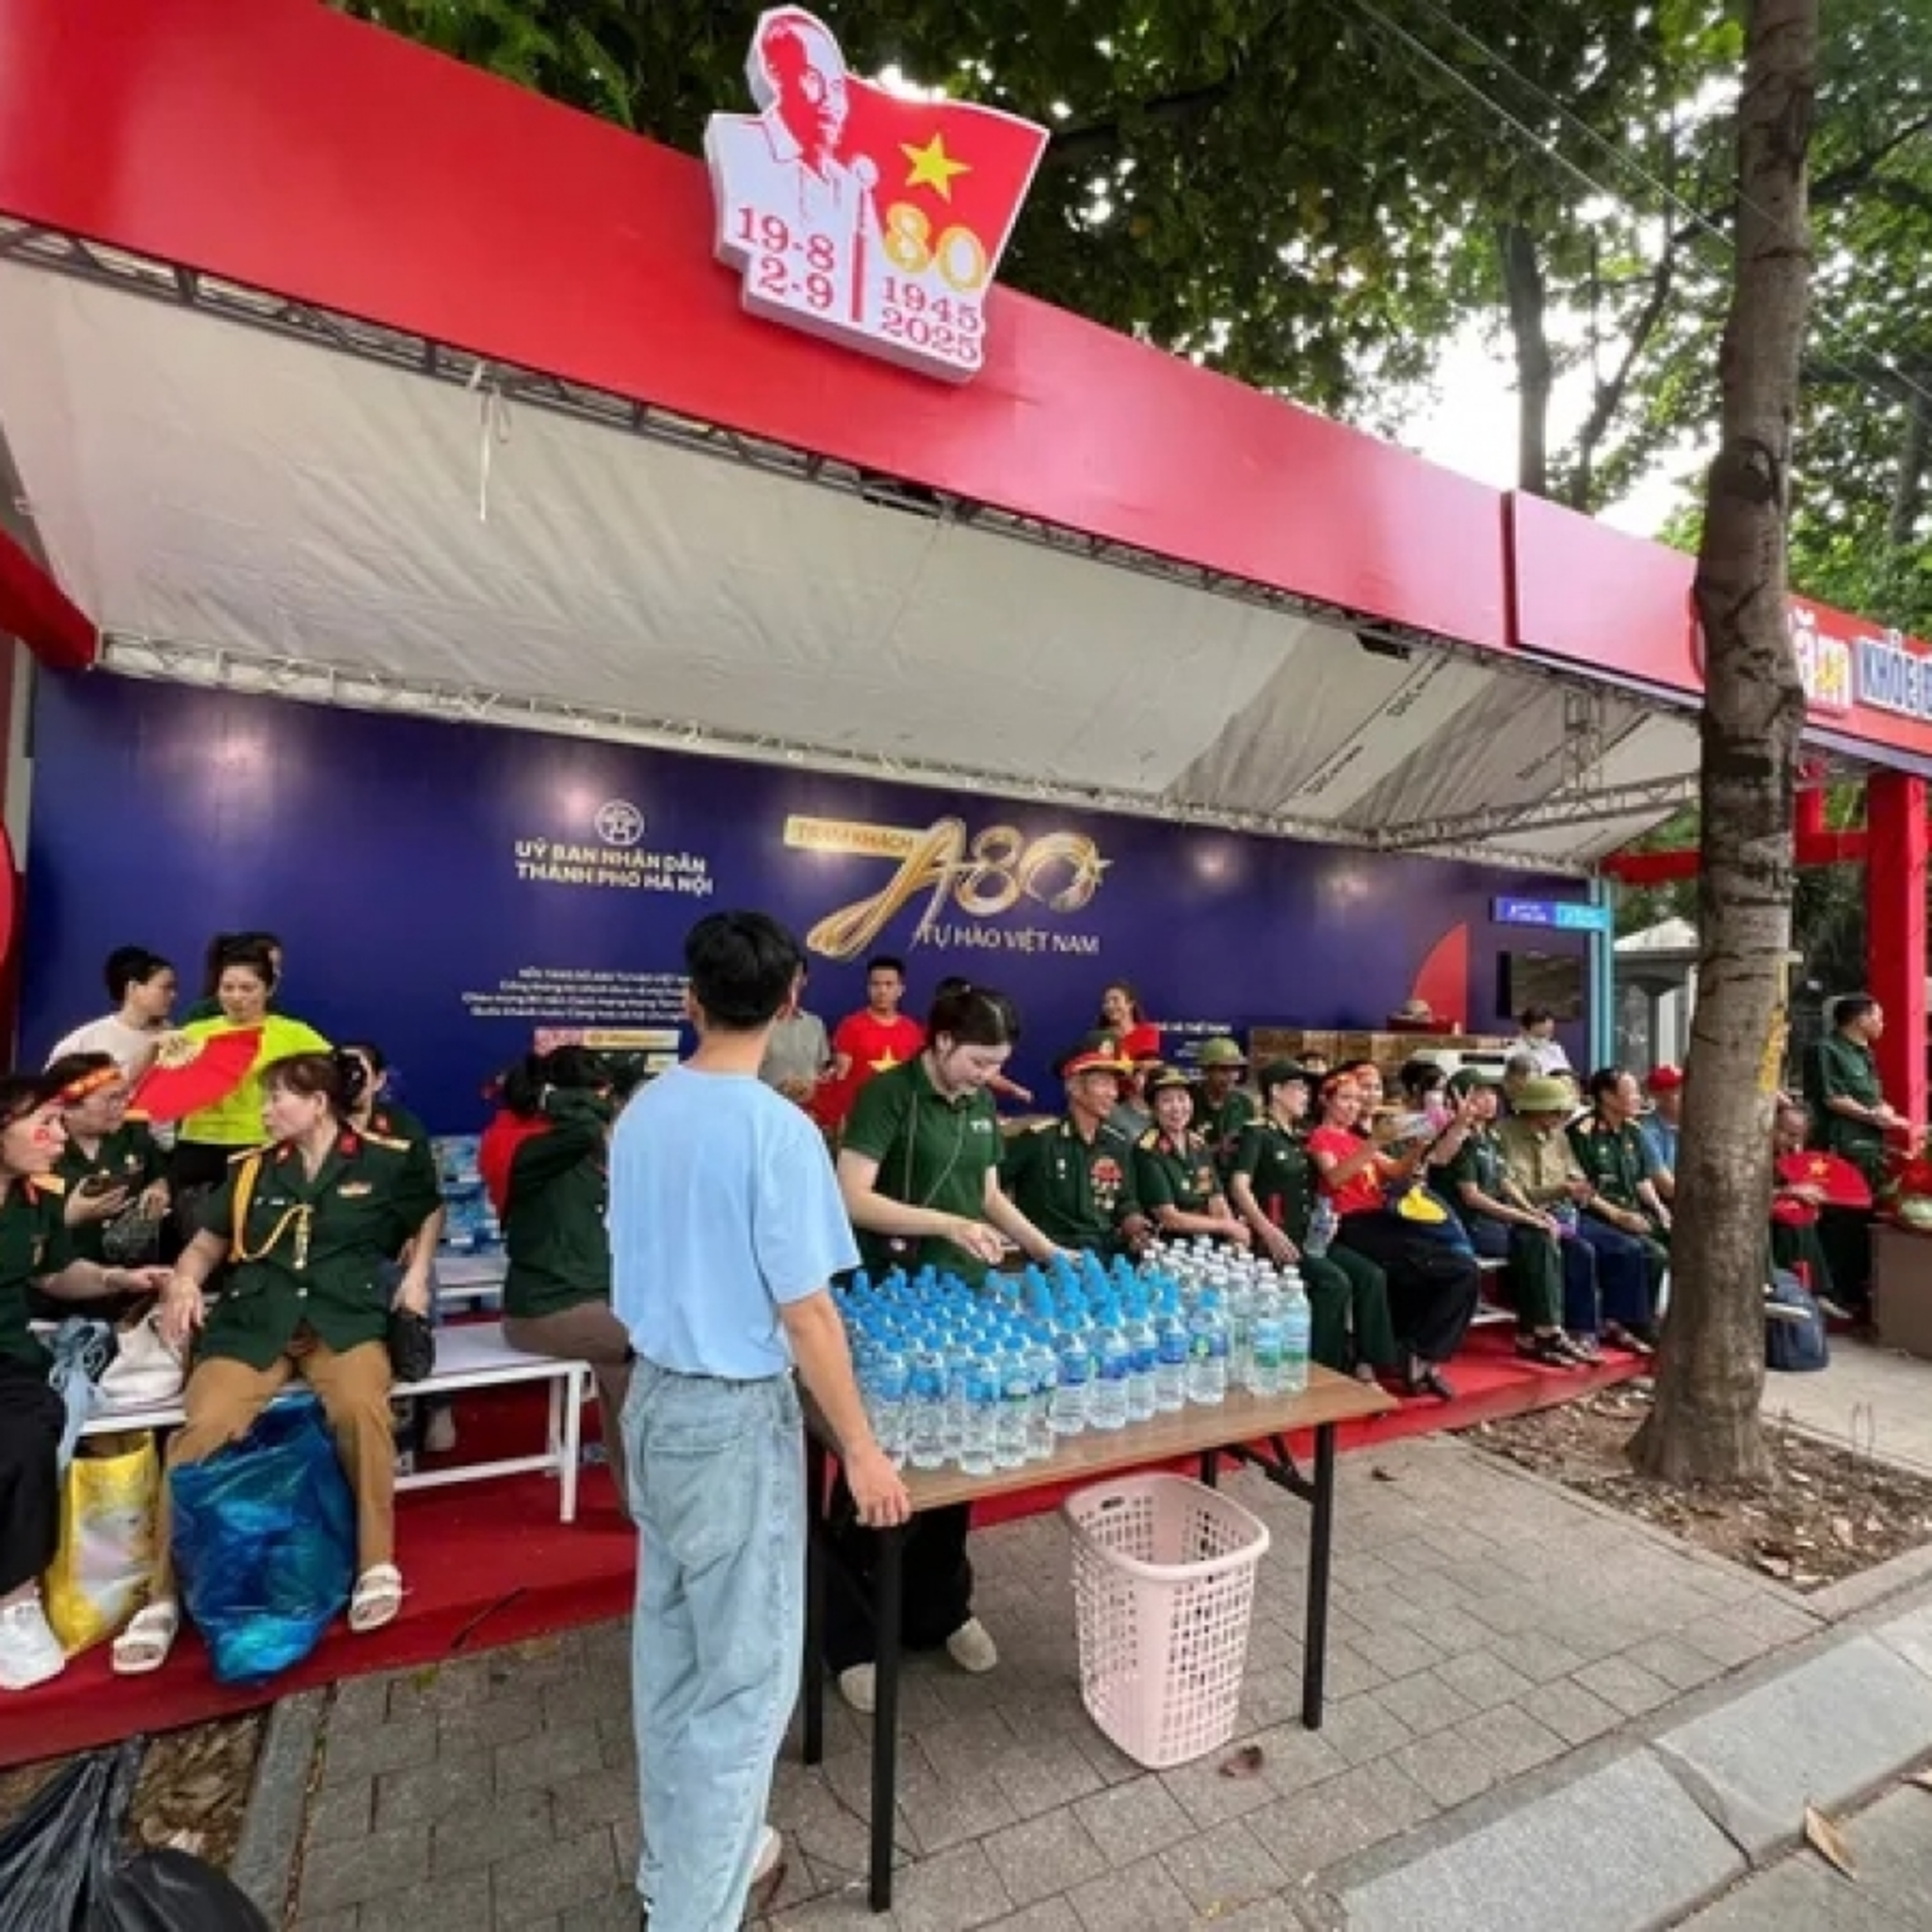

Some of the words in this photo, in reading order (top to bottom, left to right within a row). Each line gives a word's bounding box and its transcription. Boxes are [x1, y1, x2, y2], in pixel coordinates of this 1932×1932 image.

[886, 203, 986, 290] 80
[882, 276, 978, 334] 1945
[882, 310, 978, 362] 2025
[515, 860, 592, 884] THÀNH
[643, 871, 676, 892] HÀ
[677, 873, 714, 898] NỘI
[552, 844, 600, 864] BAN
[601, 847, 660, 869] NHÂN
[663, 851, 706, 873] DÂN
[954, 922, 1001, 947] HÀO
[1003, 926, 1050, 955] VIỆT
[1052, 934, 1101, 956] NAM
